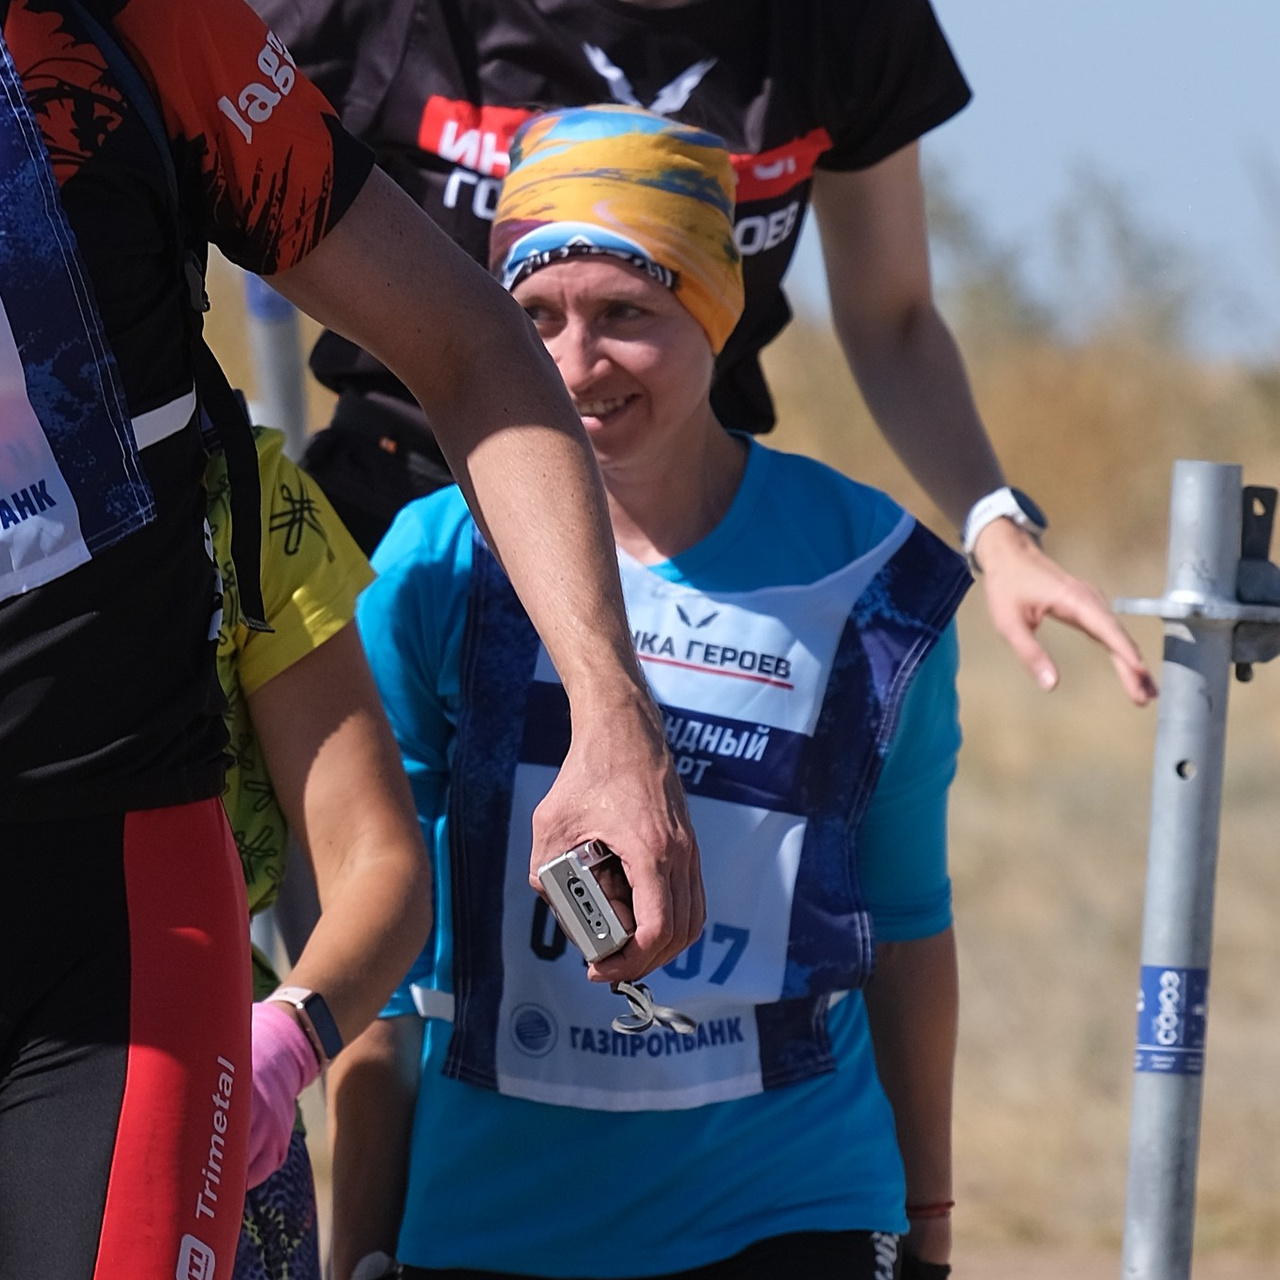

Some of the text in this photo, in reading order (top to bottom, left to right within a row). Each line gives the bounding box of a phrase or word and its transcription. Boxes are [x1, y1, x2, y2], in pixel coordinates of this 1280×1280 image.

[685, 640, 792, 680] ГЕРОЕВ
[569, 1017, 745, 1058] ГАЗПРОМБАНК
[196, 1055, 236, 1219] Trimetal
